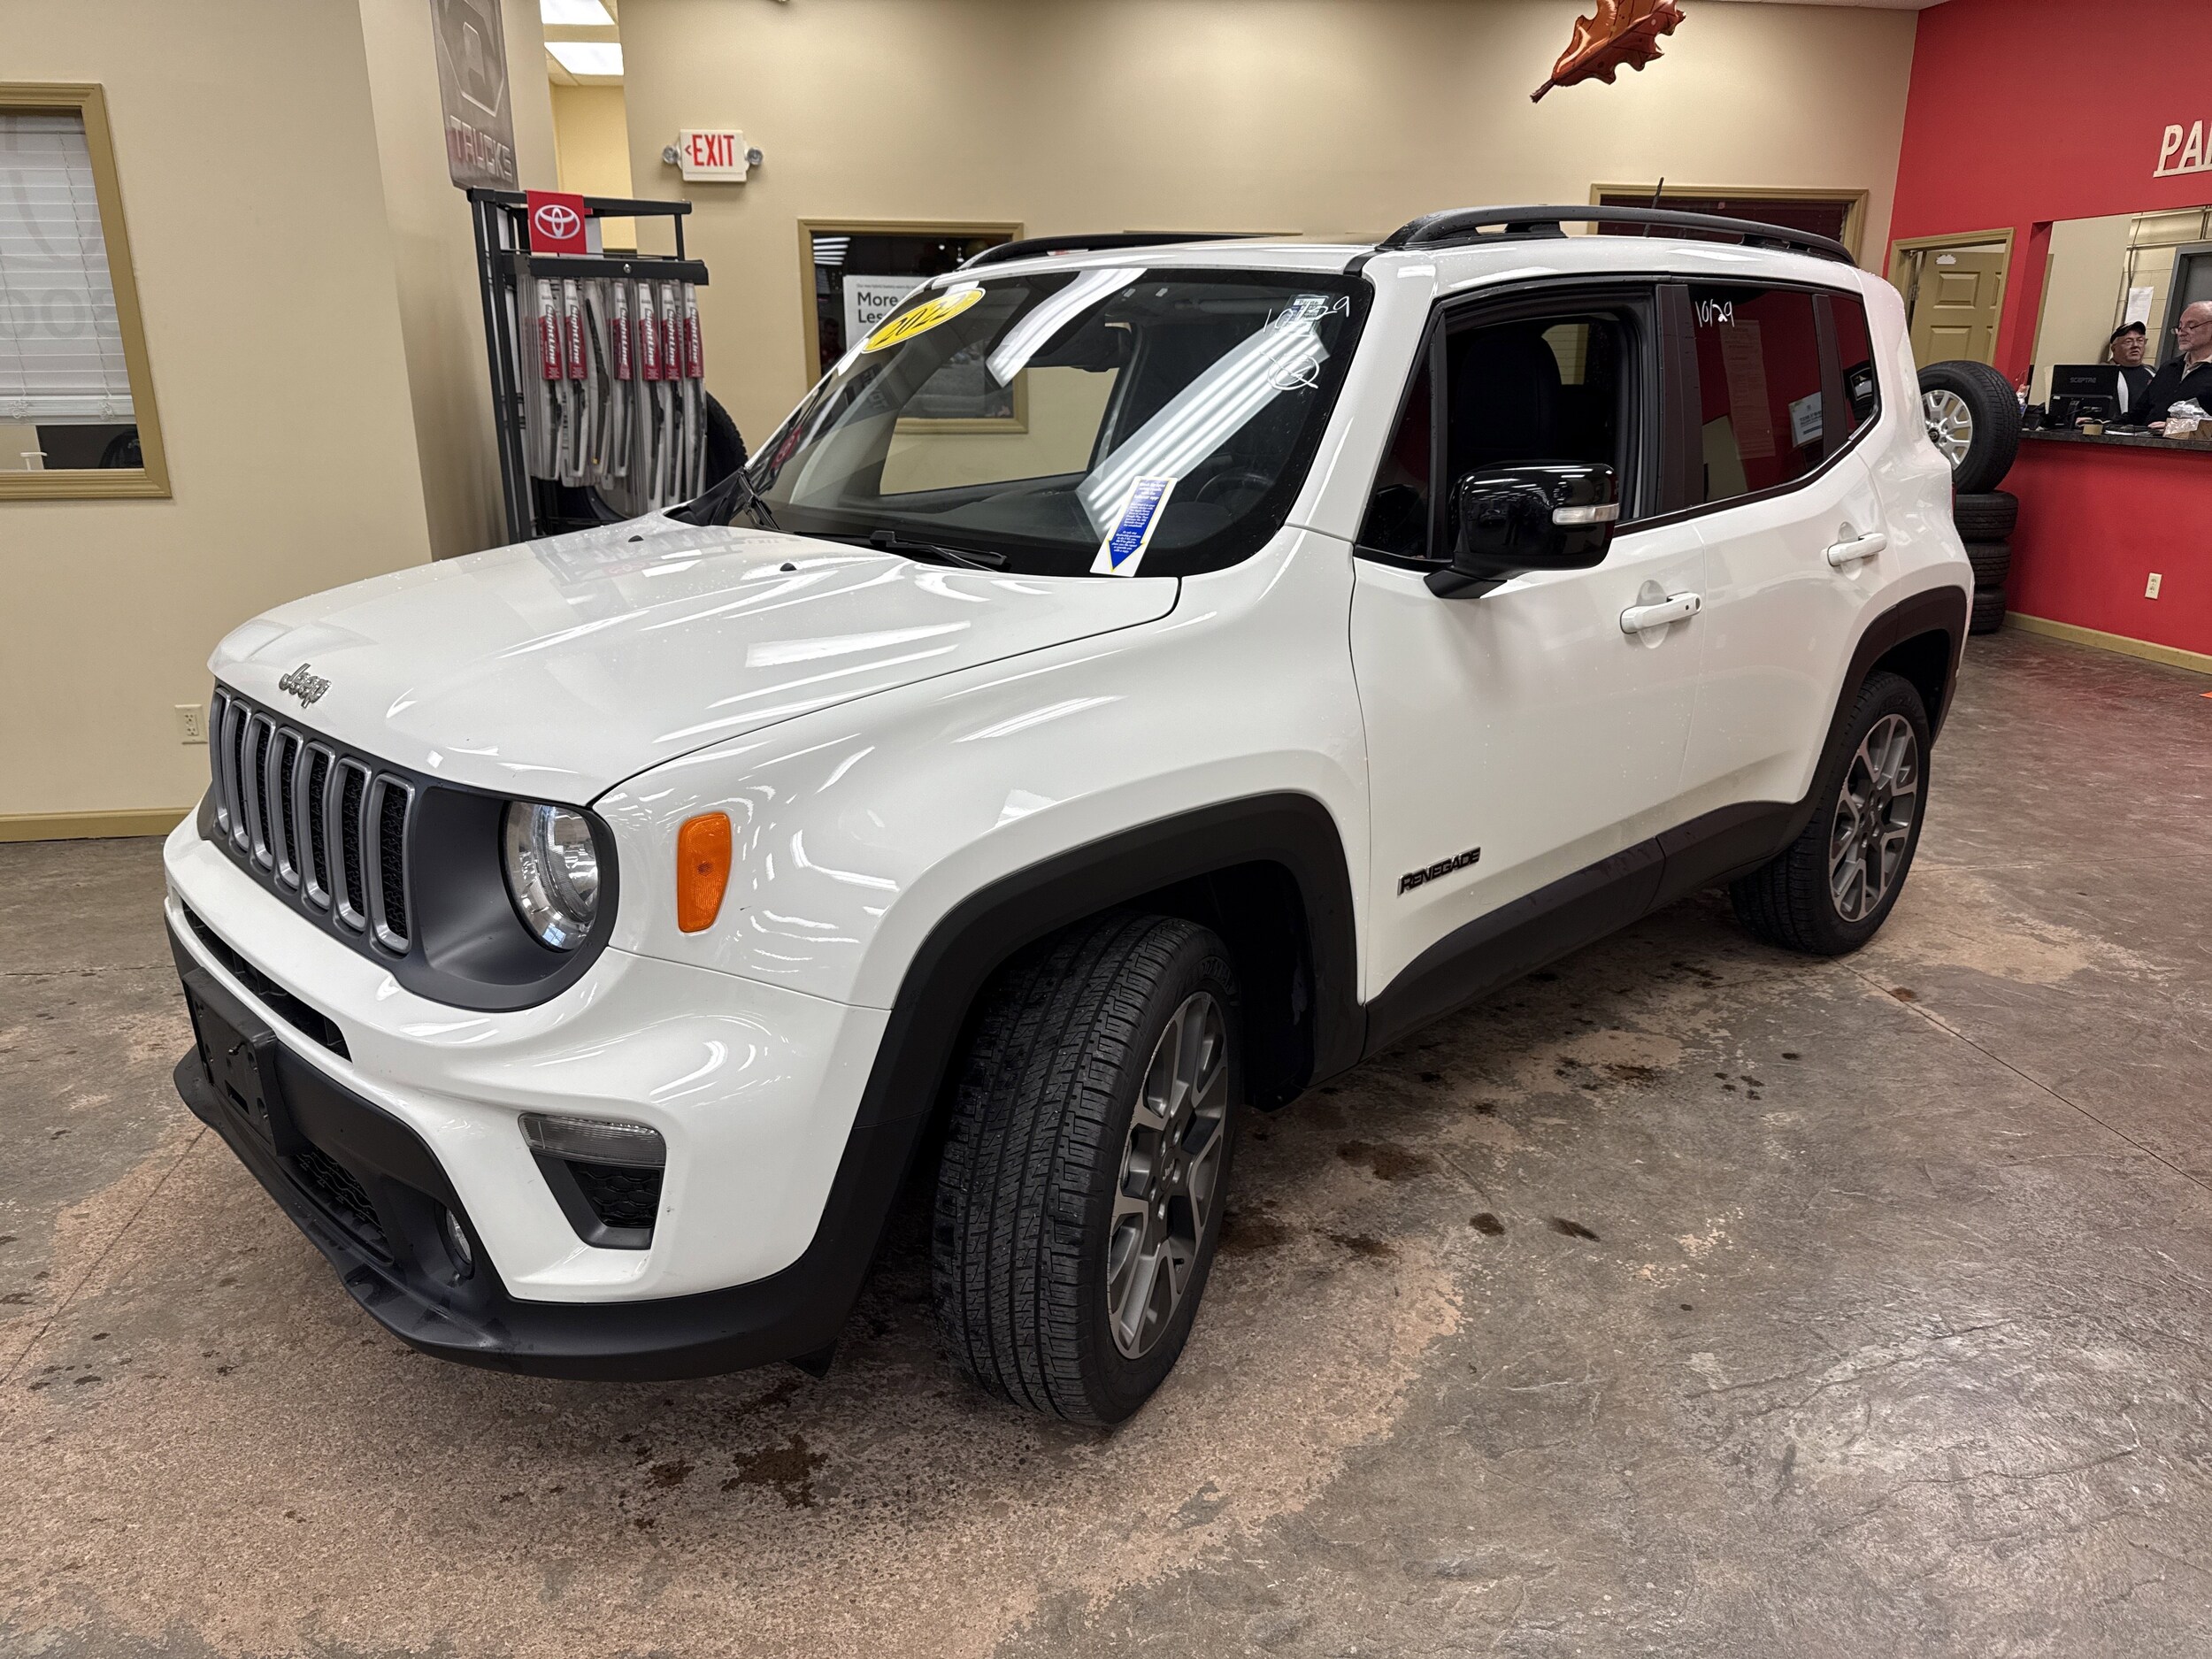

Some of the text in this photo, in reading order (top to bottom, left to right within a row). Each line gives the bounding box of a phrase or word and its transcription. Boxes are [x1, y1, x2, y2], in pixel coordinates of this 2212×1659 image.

[449, 115, 514, 183] TRUCKS
[692, 134, 734, 166] EXIT
[2154, 120, 2212, 175] PA
[857, 291, 899, 306] More
[858, 310, 886, 324] Les
[1694, 298, 1735, 327] 10/29
[571, 306, 580, 365] SightLine
[279, 663, 331, 709] Jeep
[1397, 847, 1481, 895] RENEGADE
